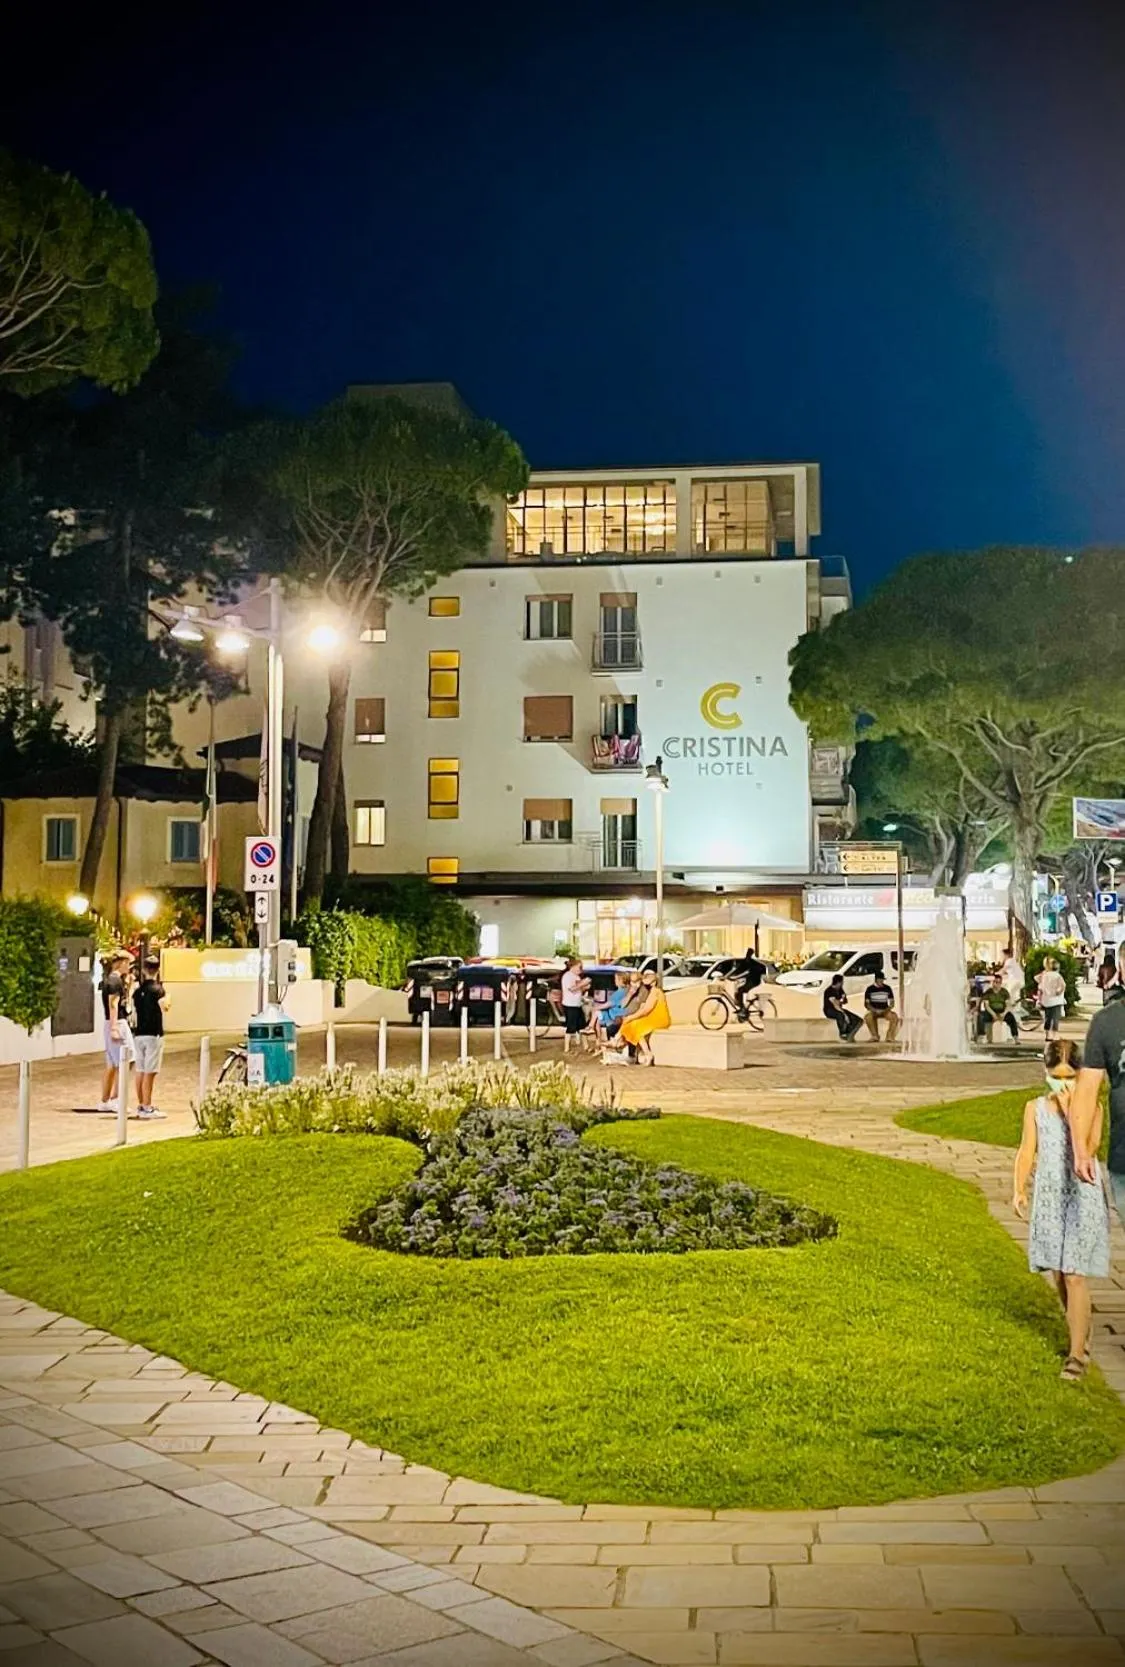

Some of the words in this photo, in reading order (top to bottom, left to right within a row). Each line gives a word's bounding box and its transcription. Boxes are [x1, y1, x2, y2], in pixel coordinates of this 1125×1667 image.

[700, 682, 743, 730] C
[662, 736, 788, 758] CRISTINA
[698, 761, 753, 776] HOTEL
[250, 874, 275, 885] 0-24
[807, 893, 874, 905] Ristorante
[1100, 894, 1114, 911] P
